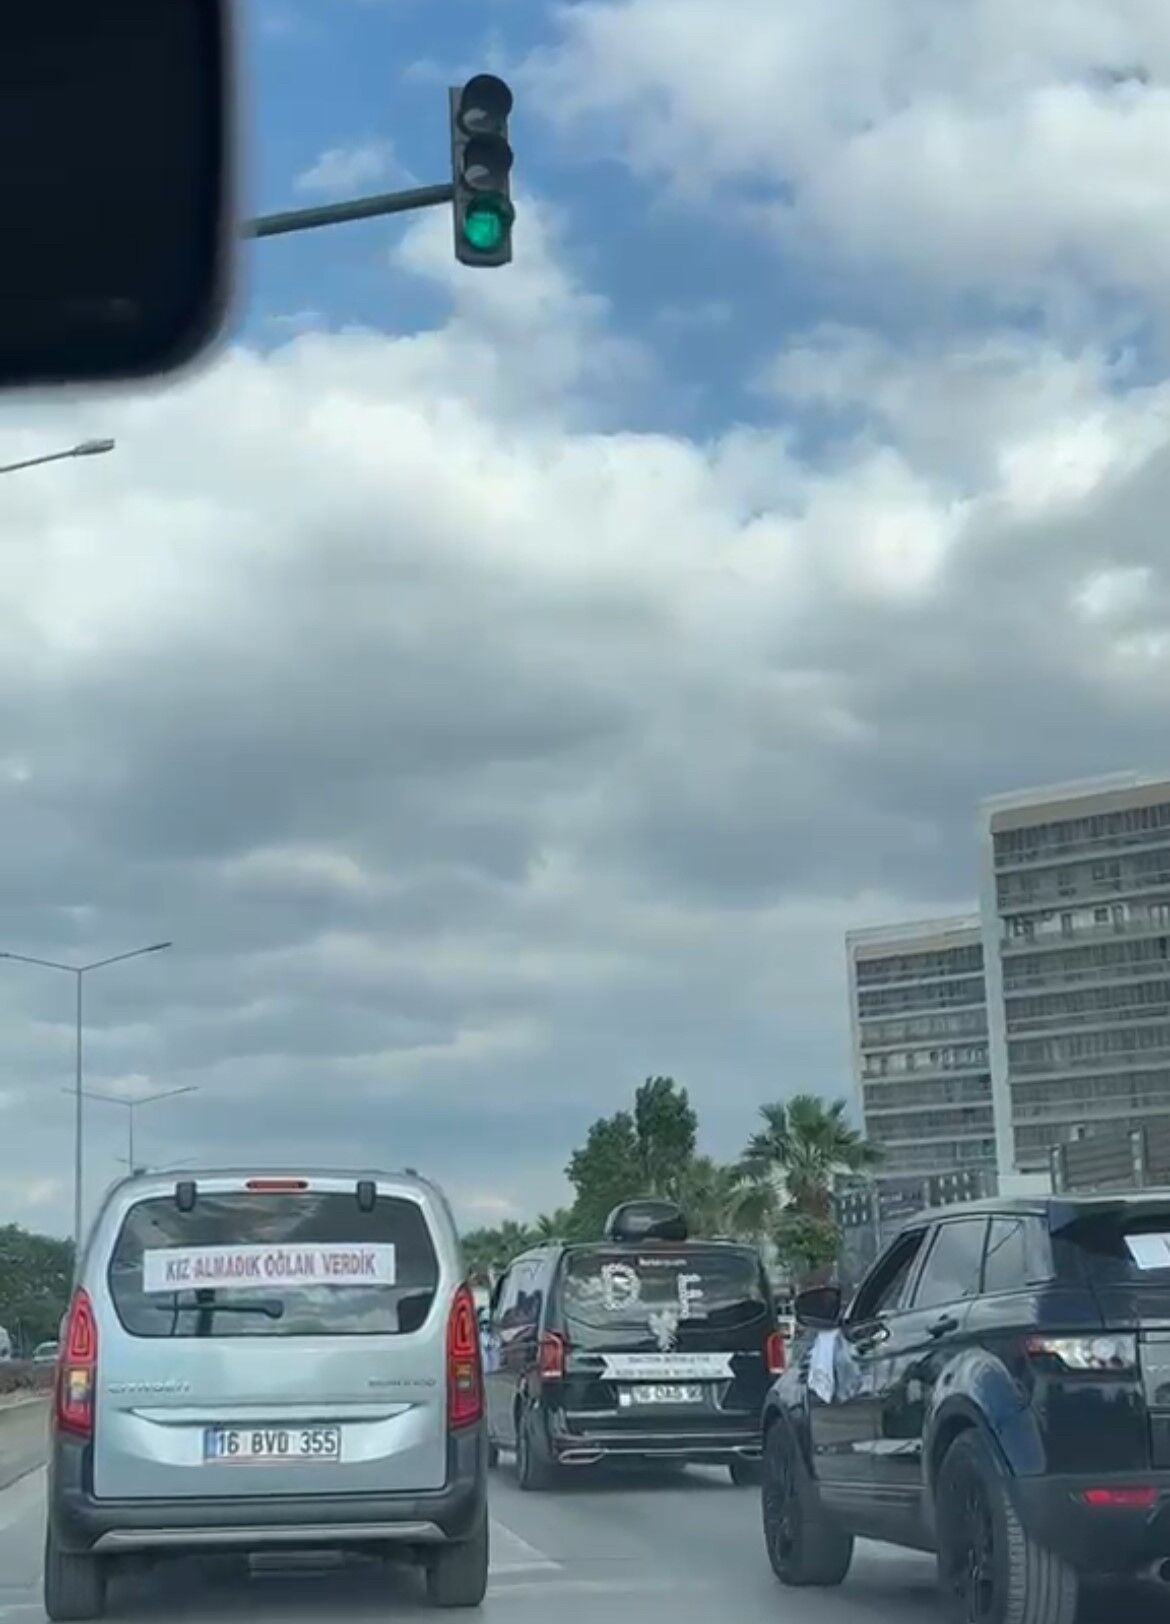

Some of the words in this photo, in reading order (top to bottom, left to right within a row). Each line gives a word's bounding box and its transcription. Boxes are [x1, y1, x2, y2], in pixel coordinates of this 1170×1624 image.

[165, 1258, 191, 1282] KIZ
[194, 1254, 261, 1279] ALMADIK
[263, 1249, 315, 1277] OĞLAN
[320, 1249, 376, 1276] VERDİK
[218, 1431, 239, 1454] 16
[300, 1431, 336, 1453] 355
